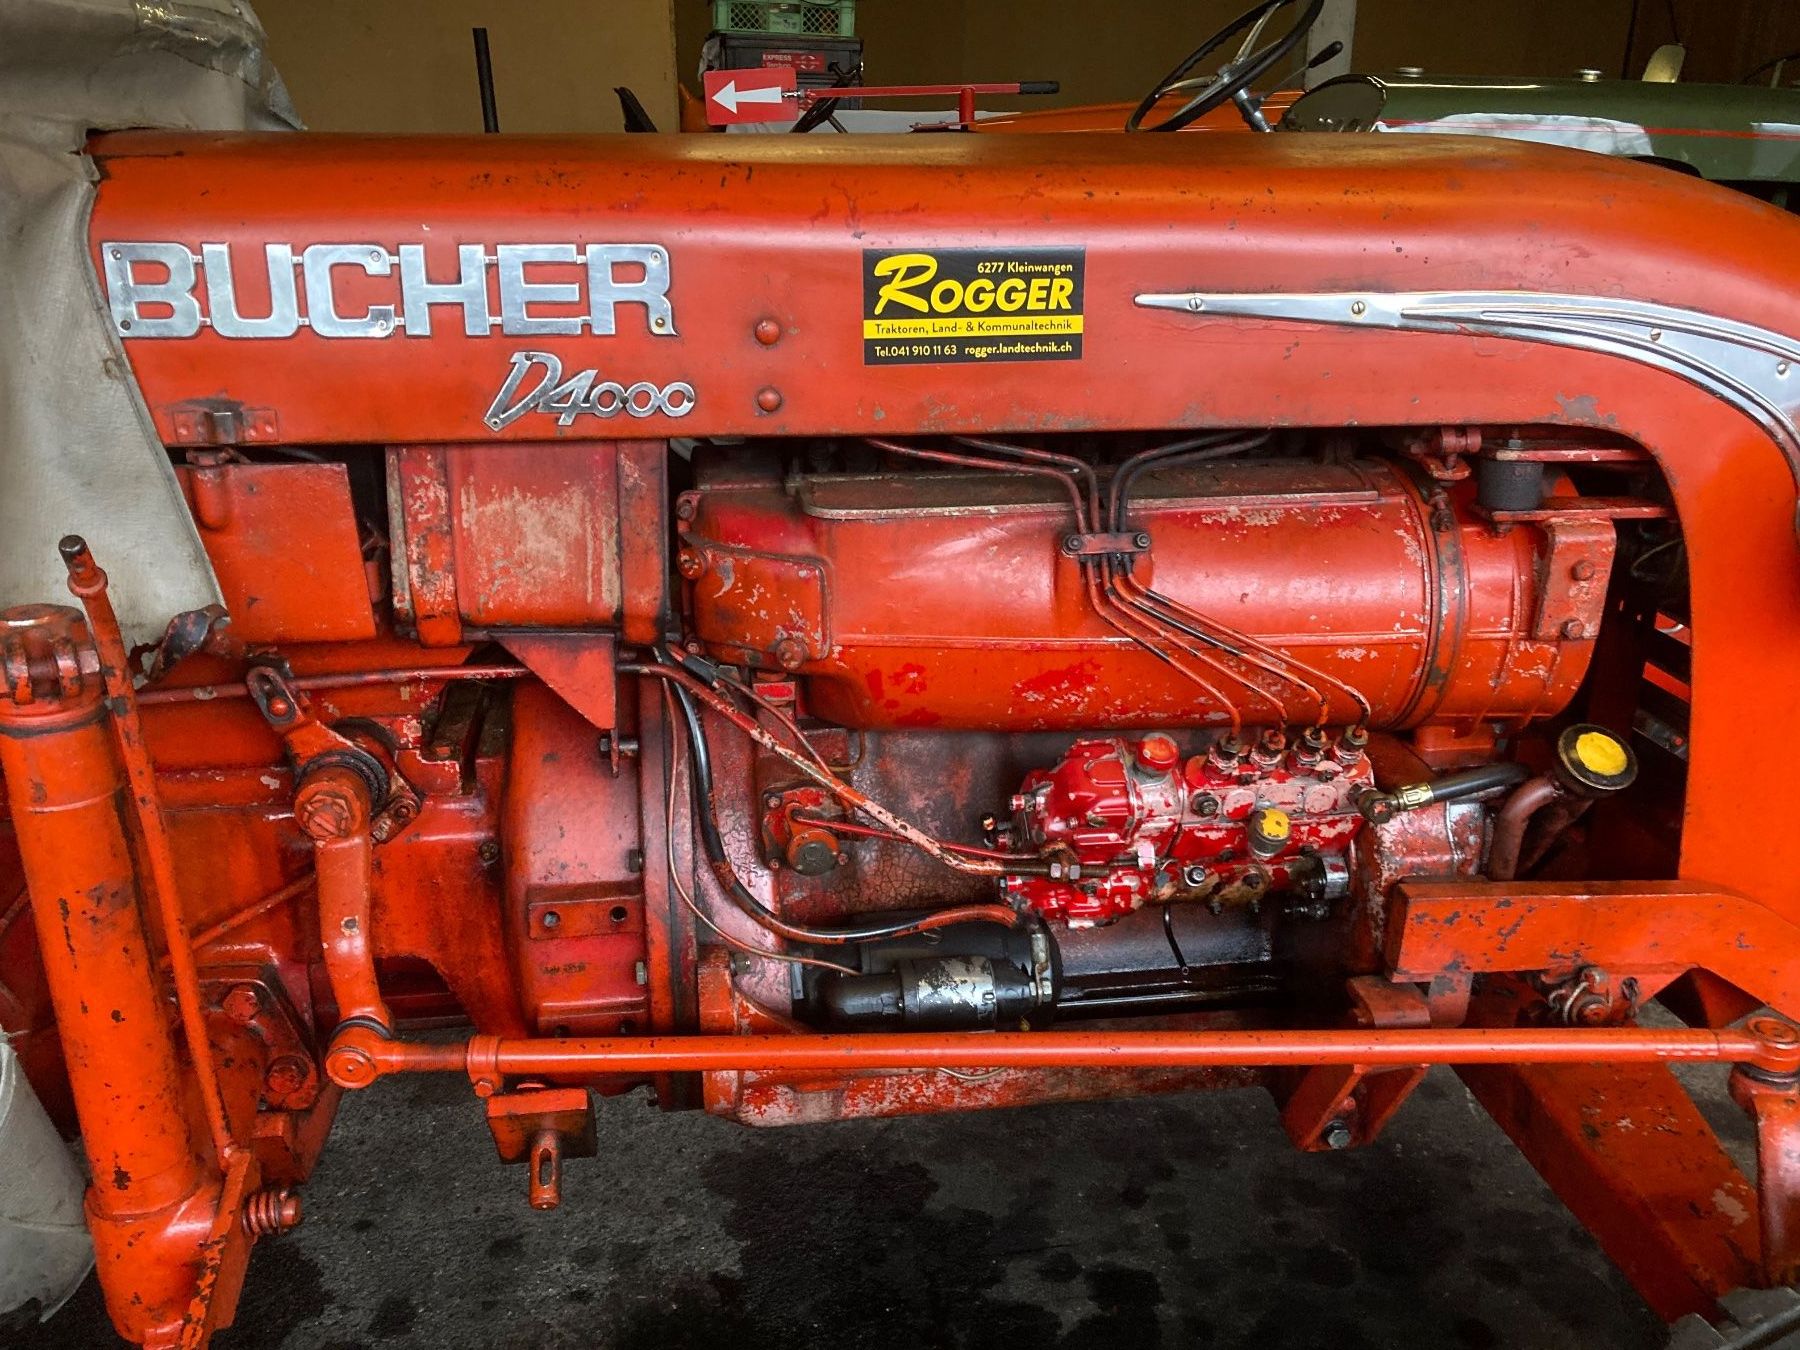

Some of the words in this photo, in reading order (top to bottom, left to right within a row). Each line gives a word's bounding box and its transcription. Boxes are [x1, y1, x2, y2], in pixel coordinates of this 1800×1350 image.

[874, 253, 1074, 315] ROGGER
[977, 262, 1005, 274] 6277
[1007, 261, 1073, 276] Kleinwangen
[102, 242, 678, 337] BUCHER
[875, 323, 929, 336] Traktoren,
[932, 322, 962, 333] Land-
[966, 321, 974, 332] &
[978, 319, 1073, 332] Kommunaltechnik
[874, 346, 910, 357] Tel.041
[912, 345, 931, 356] 910
[933, 345, 941, 355] 11
[944, 344, 957, 355] 63
[964, 341, 1073, 358] rogger.landtechnik.ch
[483, 351, 695, 430] D4000
